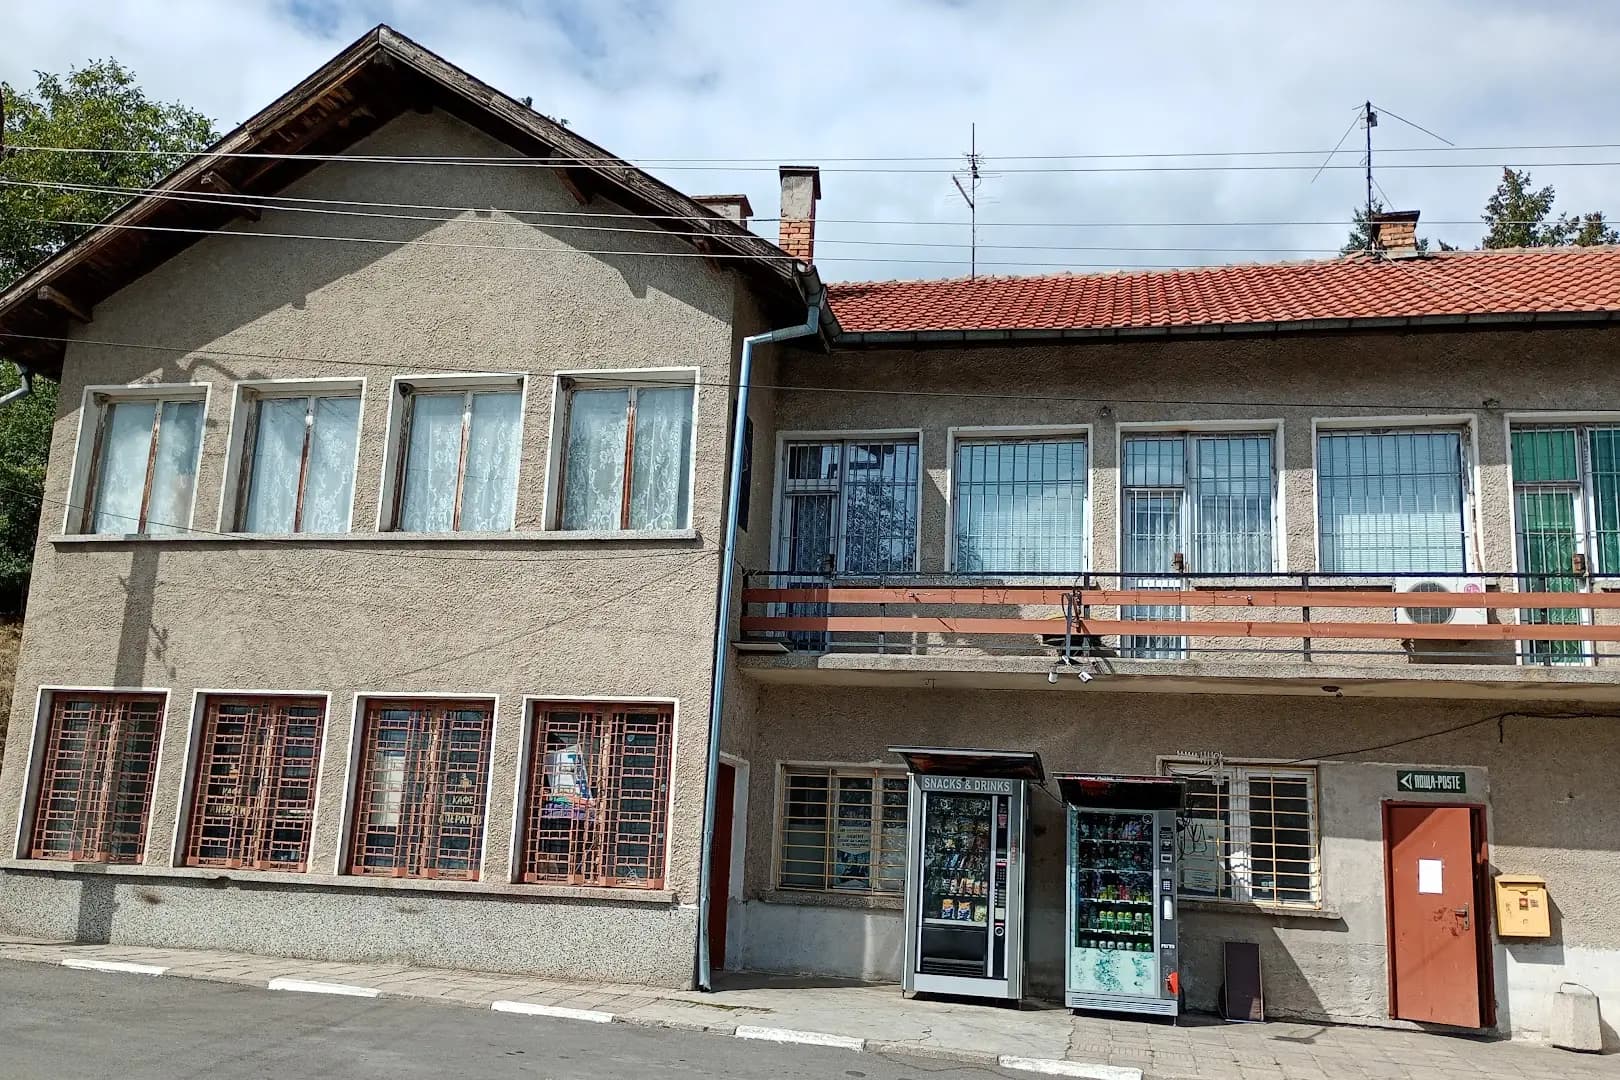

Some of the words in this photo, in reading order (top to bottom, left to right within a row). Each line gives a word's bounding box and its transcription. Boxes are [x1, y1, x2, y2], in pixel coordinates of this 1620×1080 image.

[924, 777, 962, 790] SNACKS
[964, 780, 971, 790] &
[974, 780, 1010, 792] DRINKS
[452, 795, 474, 805] КАФЕ
